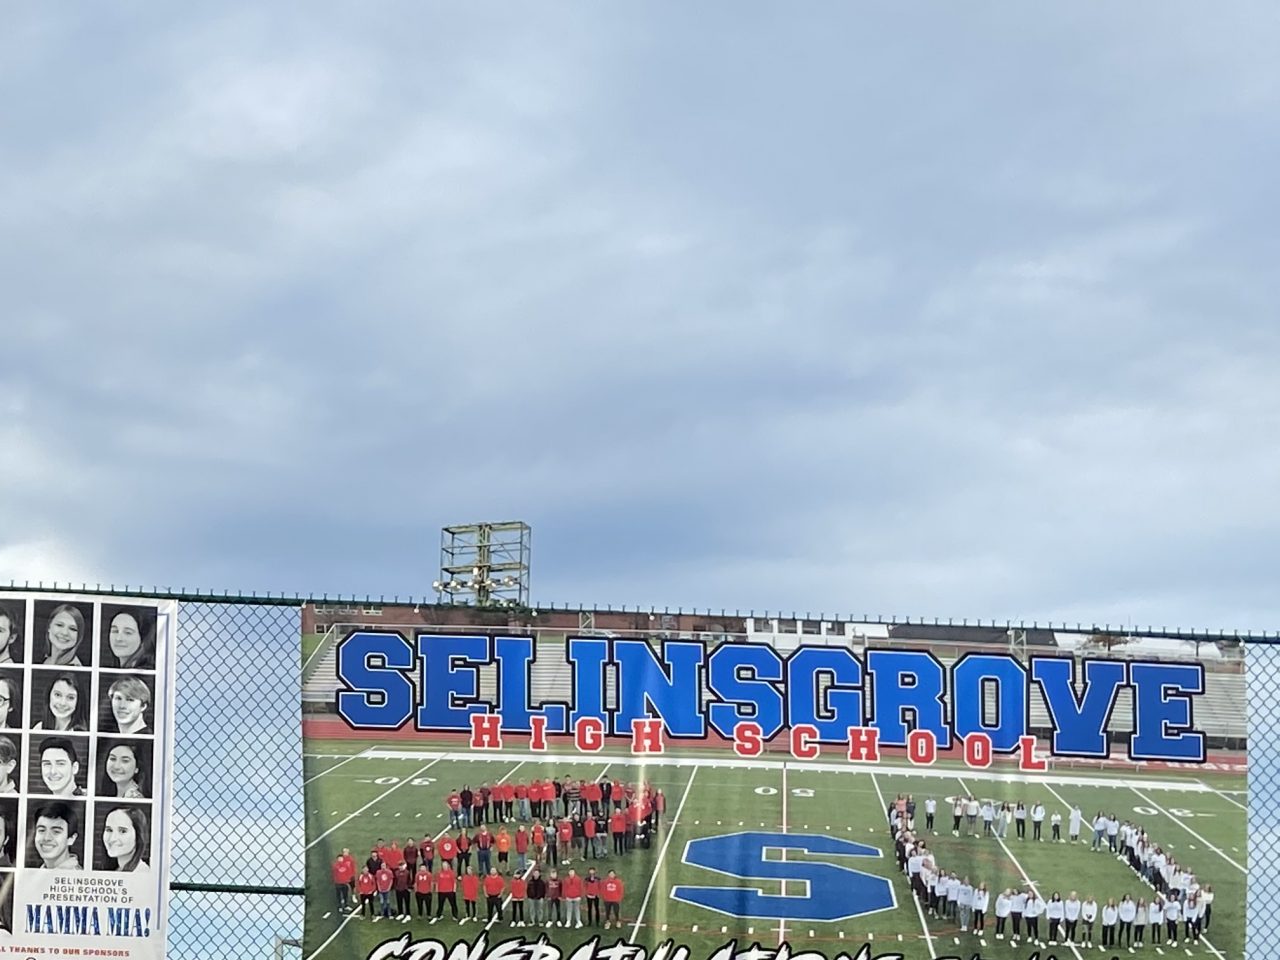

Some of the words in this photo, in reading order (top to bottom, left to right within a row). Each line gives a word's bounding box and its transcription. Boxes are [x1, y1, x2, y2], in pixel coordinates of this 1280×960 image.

[336, 630, 1207, 762] SELINSGROVE
[470, 713, 664, 755] HIGH
[732, 721, 1048, 772] SCHOOL
[54, 877, 124, 887] SELINSGROVE
[671, 831, 898, 922] S
[43, 893, 117, 904] PRESENTATION
[50, 885, 74, 893] HIGH
[25, 904, 101, 936] MAMMA
[106, 907, 151, 938] MIA!
[83, 949, 130, 957] SPONSORS
